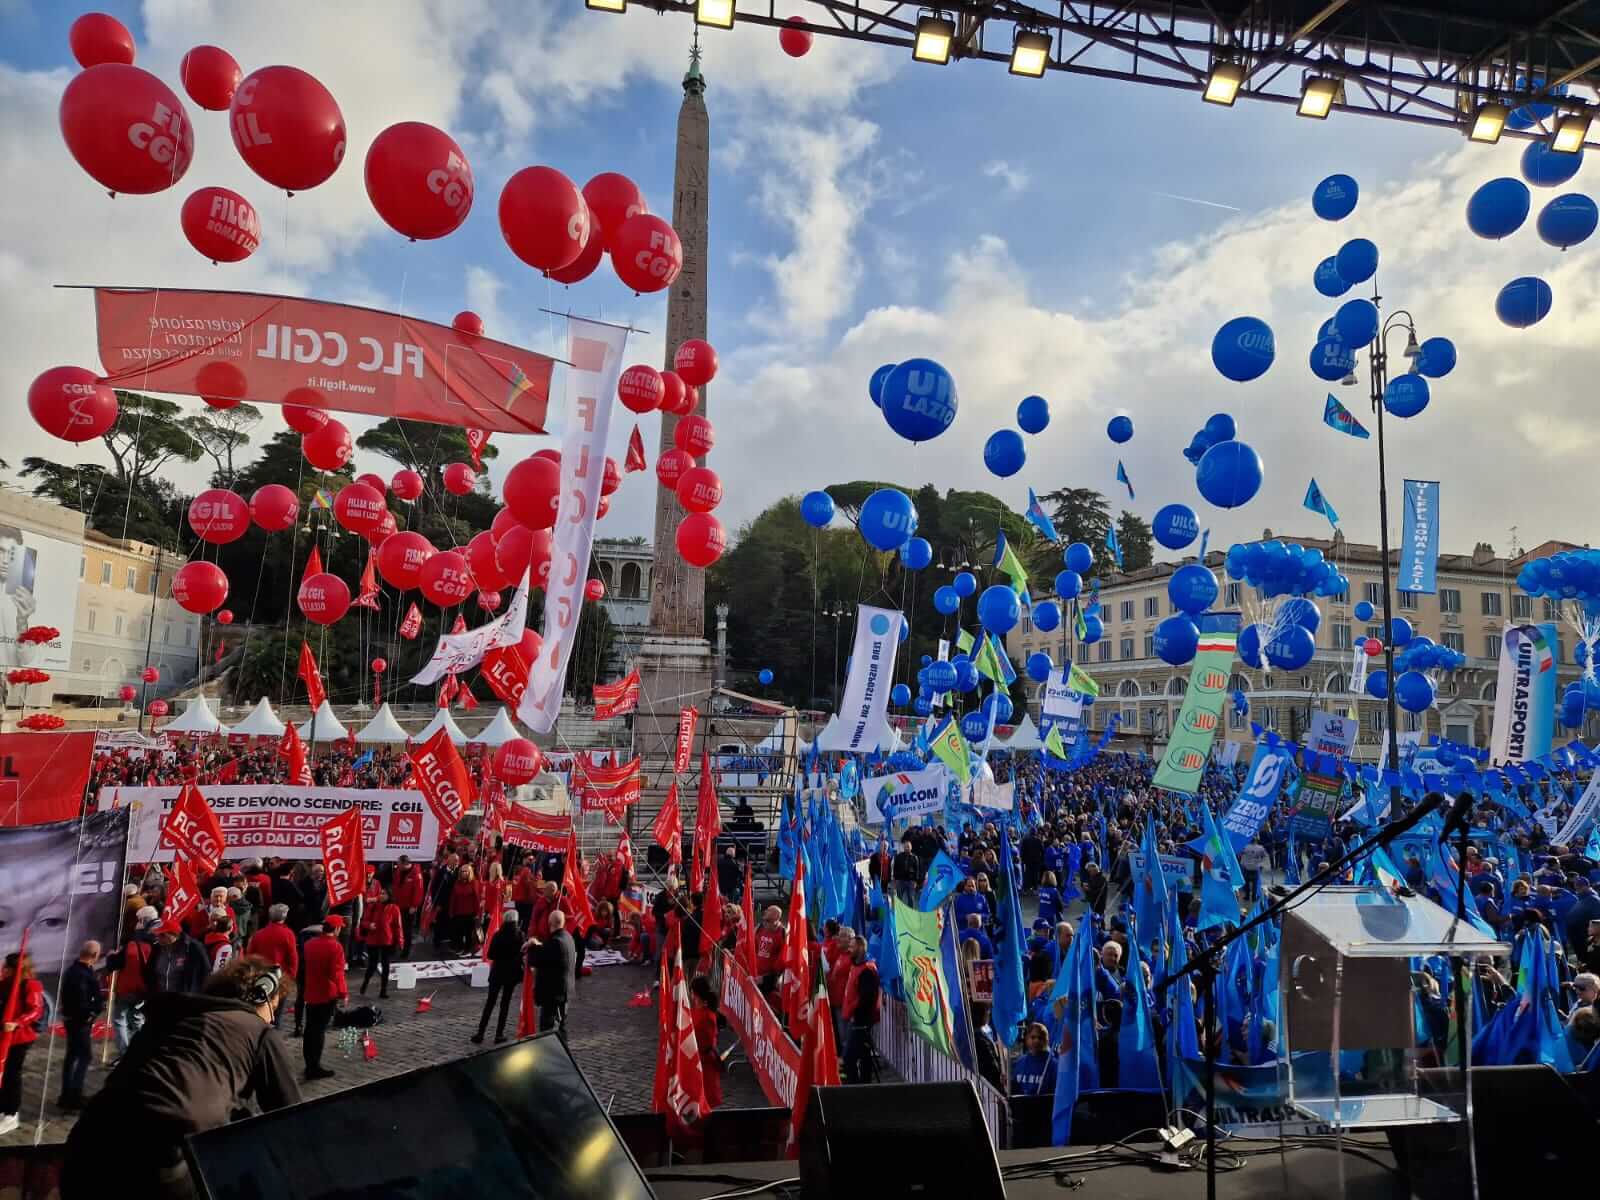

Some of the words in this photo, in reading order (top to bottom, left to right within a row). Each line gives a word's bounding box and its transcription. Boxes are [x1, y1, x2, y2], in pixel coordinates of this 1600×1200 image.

[63, 383, 97, 395] CGIL
[442, 568, 468, 583] FLC
[433, 580, 467, 598] CGIL
[1508, 643, 1532, 759] UILTRASPORTI
[238, 796, 300, 809] DEVONO
[303, 799, 383, 811] SCENDERE:
[890, 788, 938, 806] UILCOM
[391, 802, 424, 812] CGIL
[1233, 799, 1267, 820] ZERO
[242, 832, 261, 845] 60
[266, 833, 291, 845] DAI
